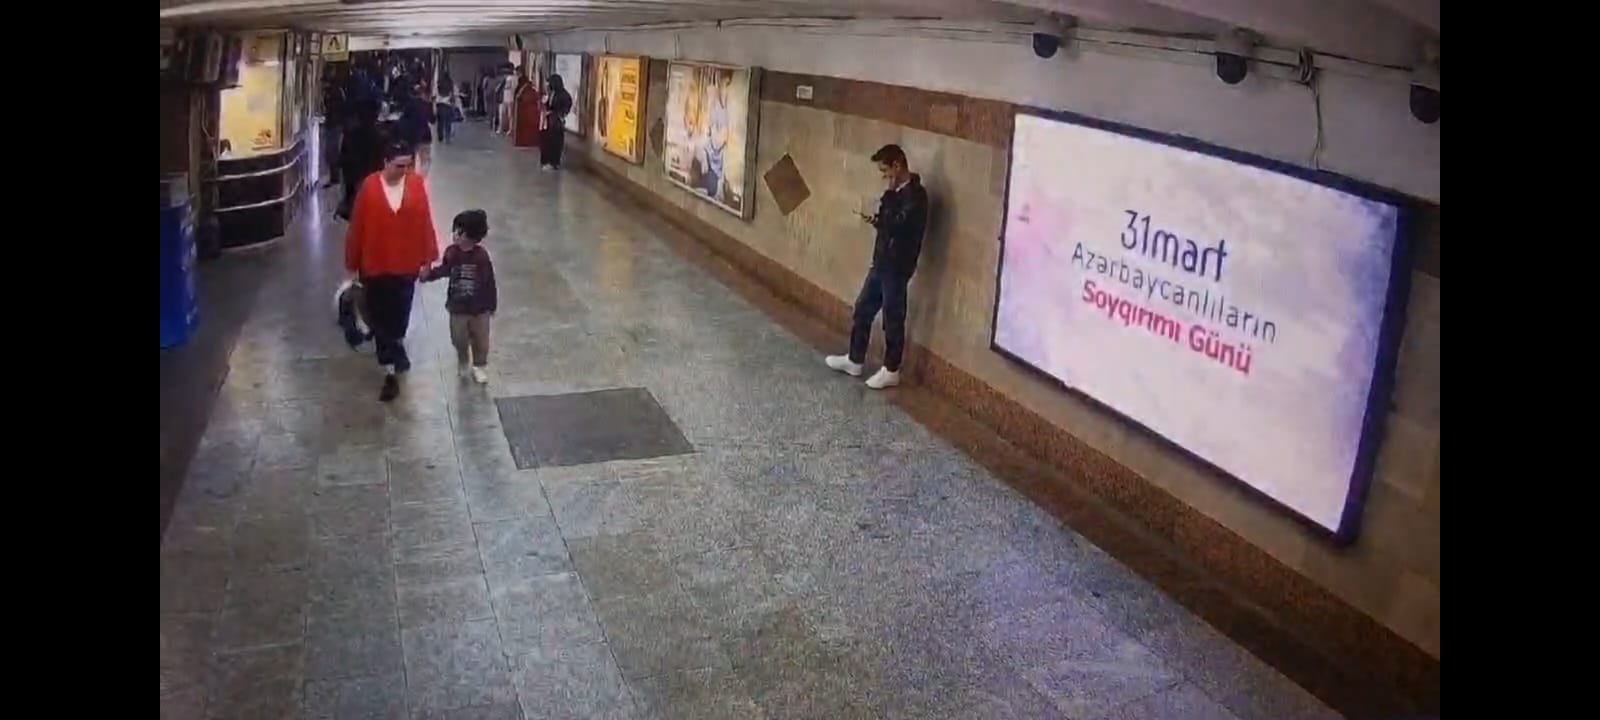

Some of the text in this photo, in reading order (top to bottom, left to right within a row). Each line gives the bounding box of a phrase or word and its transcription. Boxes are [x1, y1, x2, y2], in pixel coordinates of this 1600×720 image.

[1072, 241, 1276, 343] Azərbaycanlıların
[1082, 280, 1252, 374] Soyqırımı Günü
